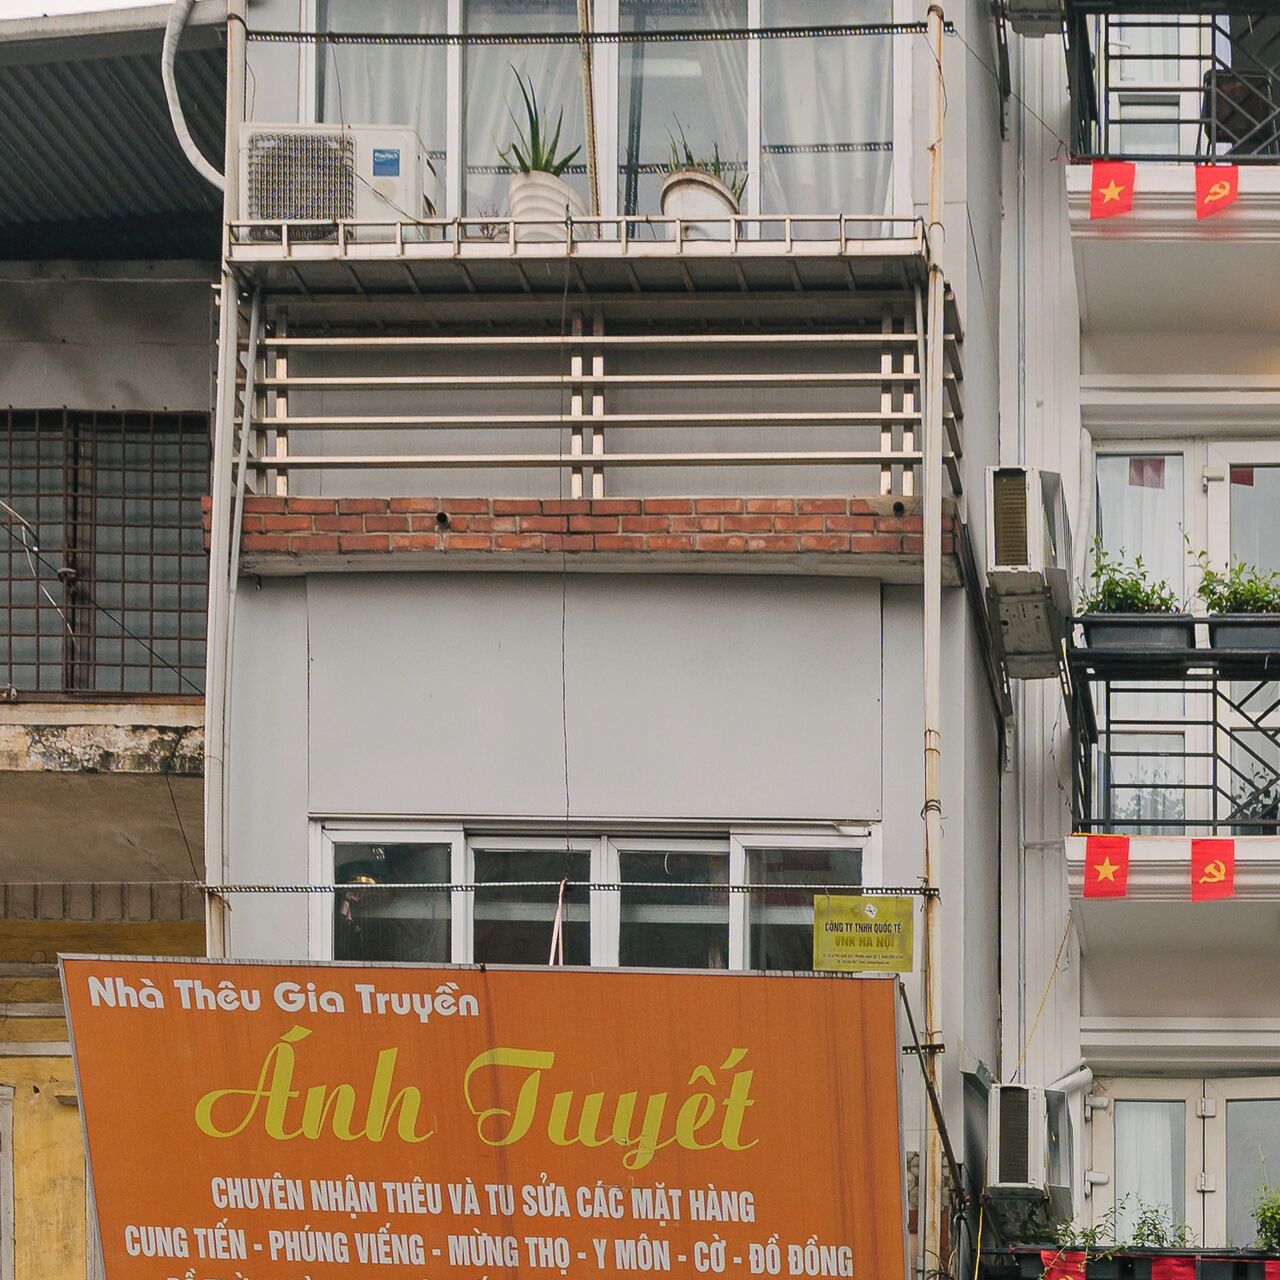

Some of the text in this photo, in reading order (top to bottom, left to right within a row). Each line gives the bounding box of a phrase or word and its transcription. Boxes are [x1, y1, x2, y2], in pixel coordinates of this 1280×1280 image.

[88, 976, 479, 1023] Nhà Thêu Gia Truyền
[195, 1025, 760, 1170] Ánh Tuyết
[211, 1172, 755, 1227] CHUYÊN NHẬN THÊU VÀ TU SỬA CÁC MẶT HÀNG
[124, 1218, 854, 1278] CUNG TIẾN PHÚNG VIẾNG MỪNG THỌ Y MÔN CỜ ĐỒ ĐỒNG
